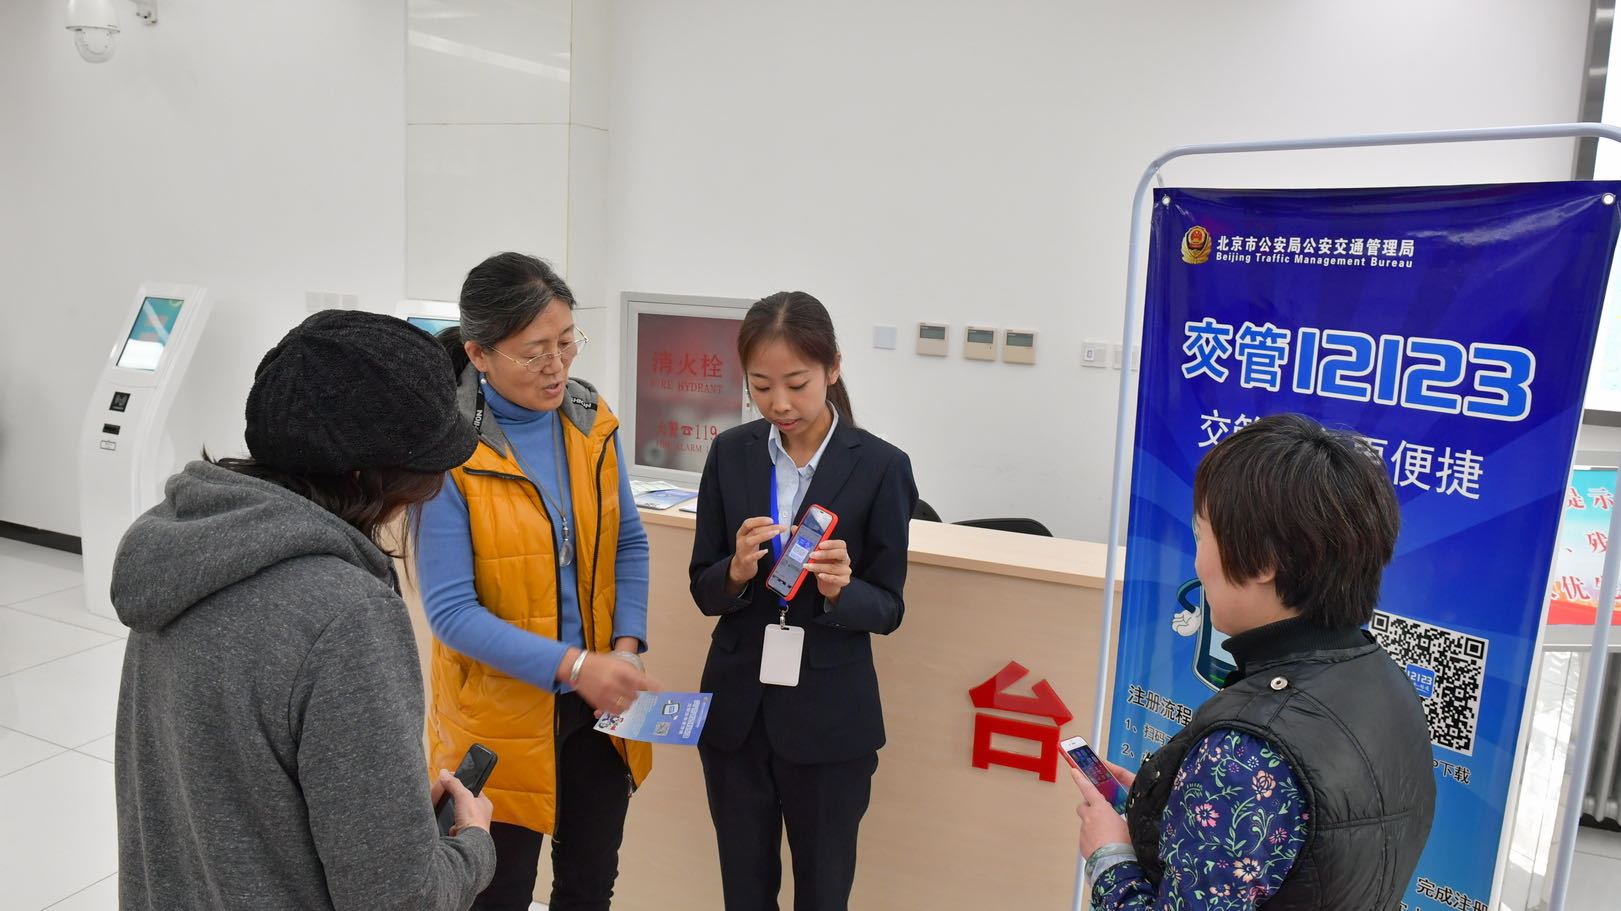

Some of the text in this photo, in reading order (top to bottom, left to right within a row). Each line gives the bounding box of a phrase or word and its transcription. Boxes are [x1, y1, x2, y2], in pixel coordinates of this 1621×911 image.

[1216, 235, 1415, 257] 北京市公安局公安交通管理局
[1216, 252, 1413, 268] Beijing Traffic Management Bureau
[1181, 317, 1536, 422] 交管12123
[969, 660, 1074, 783] 台
[1127, 684, 1193, 728] 注册流程
